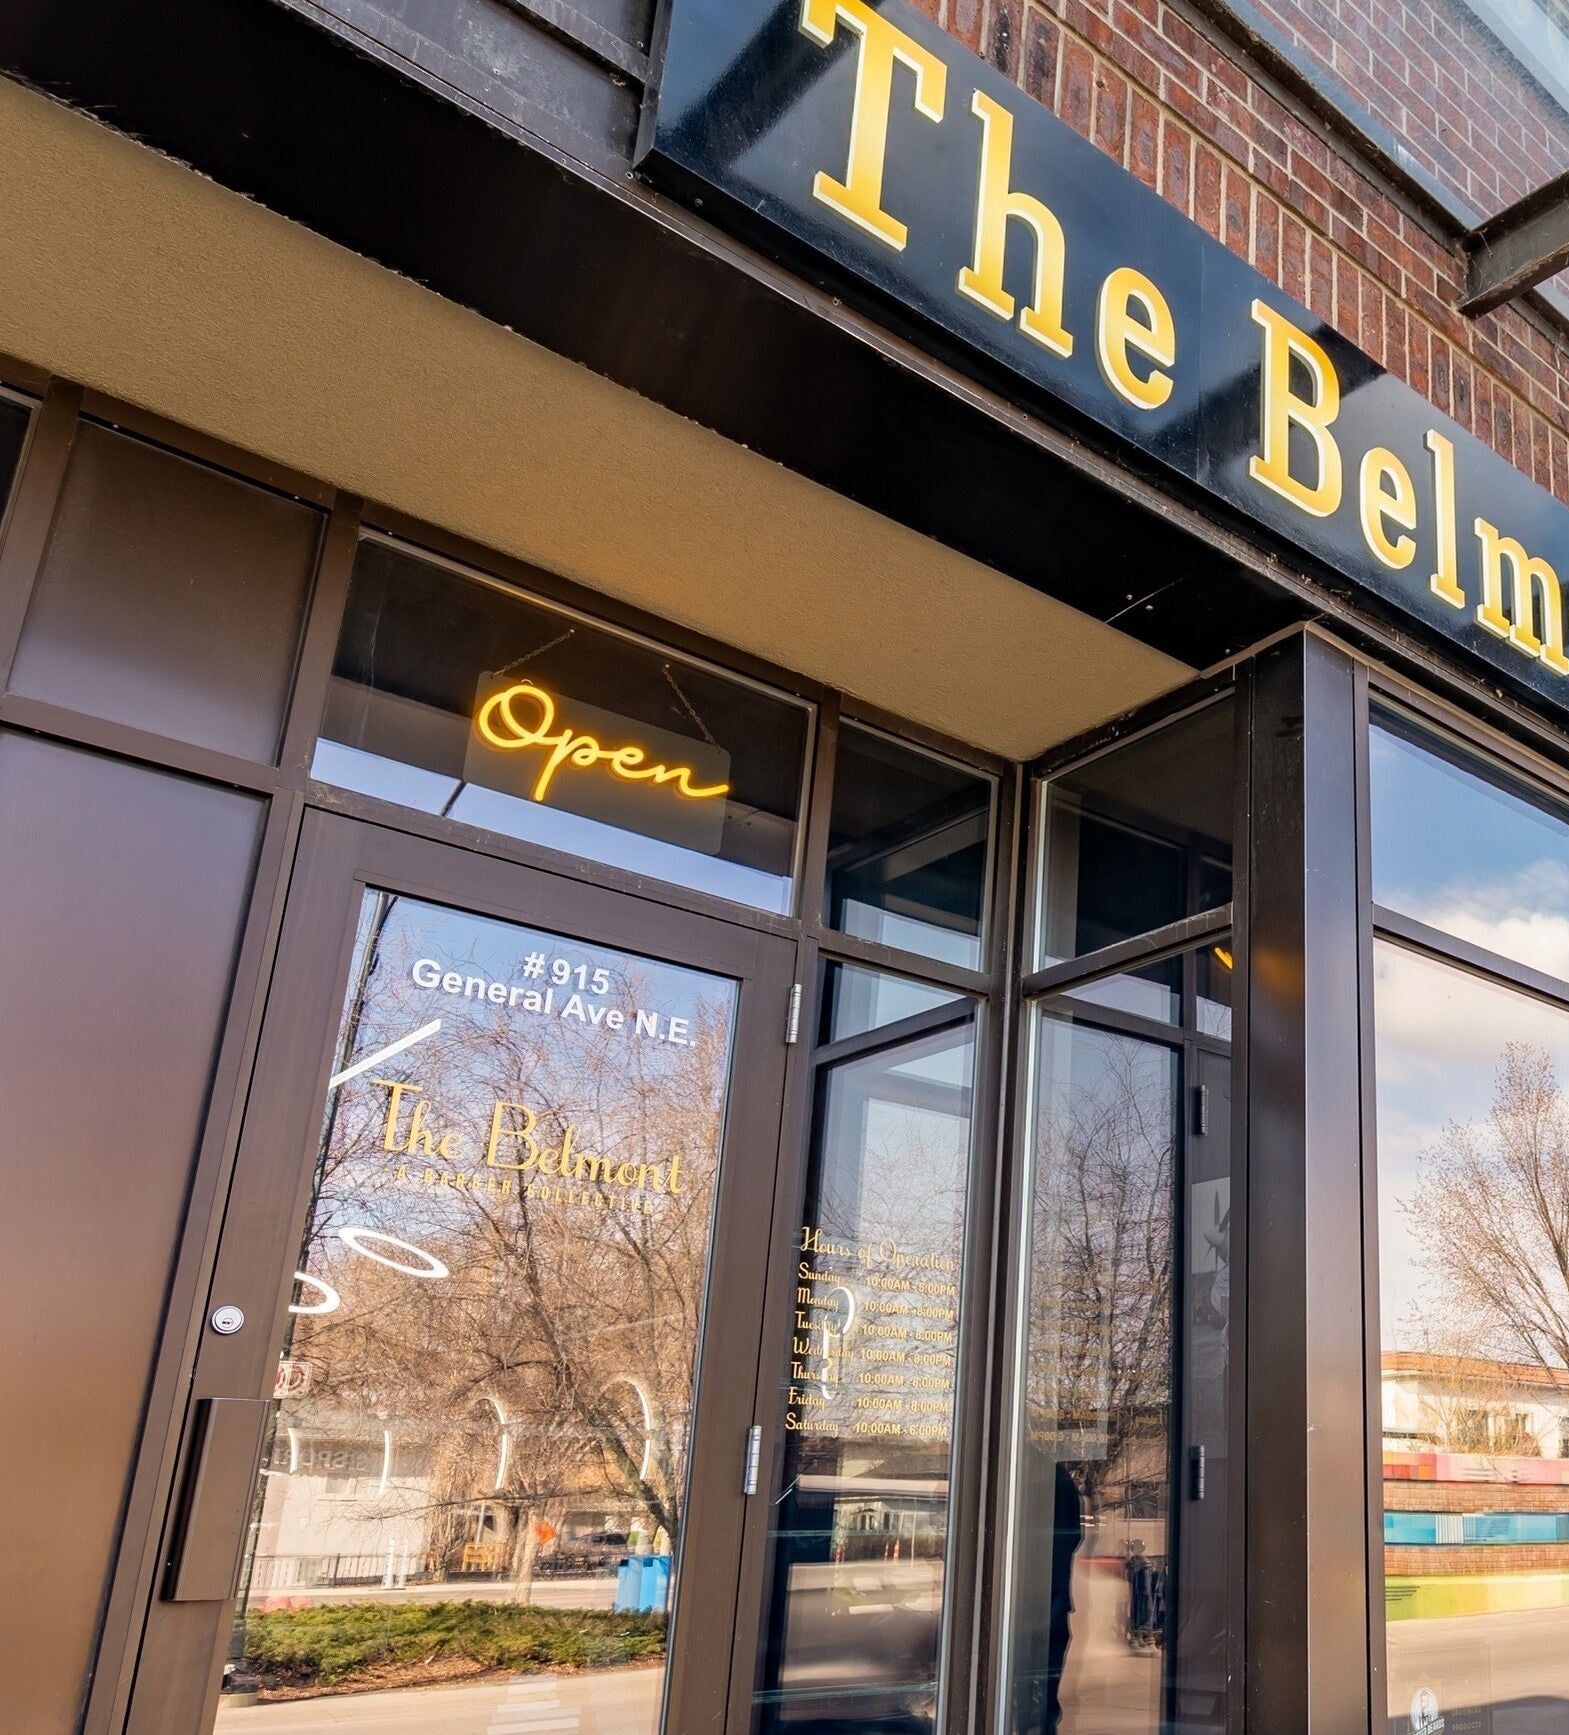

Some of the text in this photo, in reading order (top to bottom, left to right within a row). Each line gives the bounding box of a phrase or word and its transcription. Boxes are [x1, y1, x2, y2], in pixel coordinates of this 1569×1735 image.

[800, 0, 1176, 411] The
[479, 684, 730, 802] Open
[411, 958, 697, 1047] General Ave N.E.
[372, 1078, 684, 1195] The Belmont
[423, 1167, 512, 1195] BARBER
[527, 1182, 653, 1215] COLLECTIVE
[800, 1226, 956, 1271] Hours of Operation
[798, 1261, 841, 1286] Sunday
[865, 1276, 910, 1291] 10:00AM
[797, 1287, 840, 1313] Monday
[864, 1301, 908, 1315] 10:00AM
[917, 1306, 954, 1320] 8:00PM
[862, 1324, 907, 1338] 10:00AM
[915, 1330, 953, 1344] 8:00PM
[860, 1348, 906, 1363] 10:00AM
[913, 1353, 951, 1366] 8:00PM
[859, 1372, 904, 1387] 10:00AM
[912, 1376, 950, 1389] 8:00PM
[788, 1386, 825, 1411] Friday
[857, 1397, 902, 1410] 10:00AM
[911, 1400, 948, 1413] 8:00PM
[785, 1411, 840, 1438] Saturday
[854, 1422, 901, 1435] 10:00AM
[909, 1424, 947, 1437] 6:00PM
